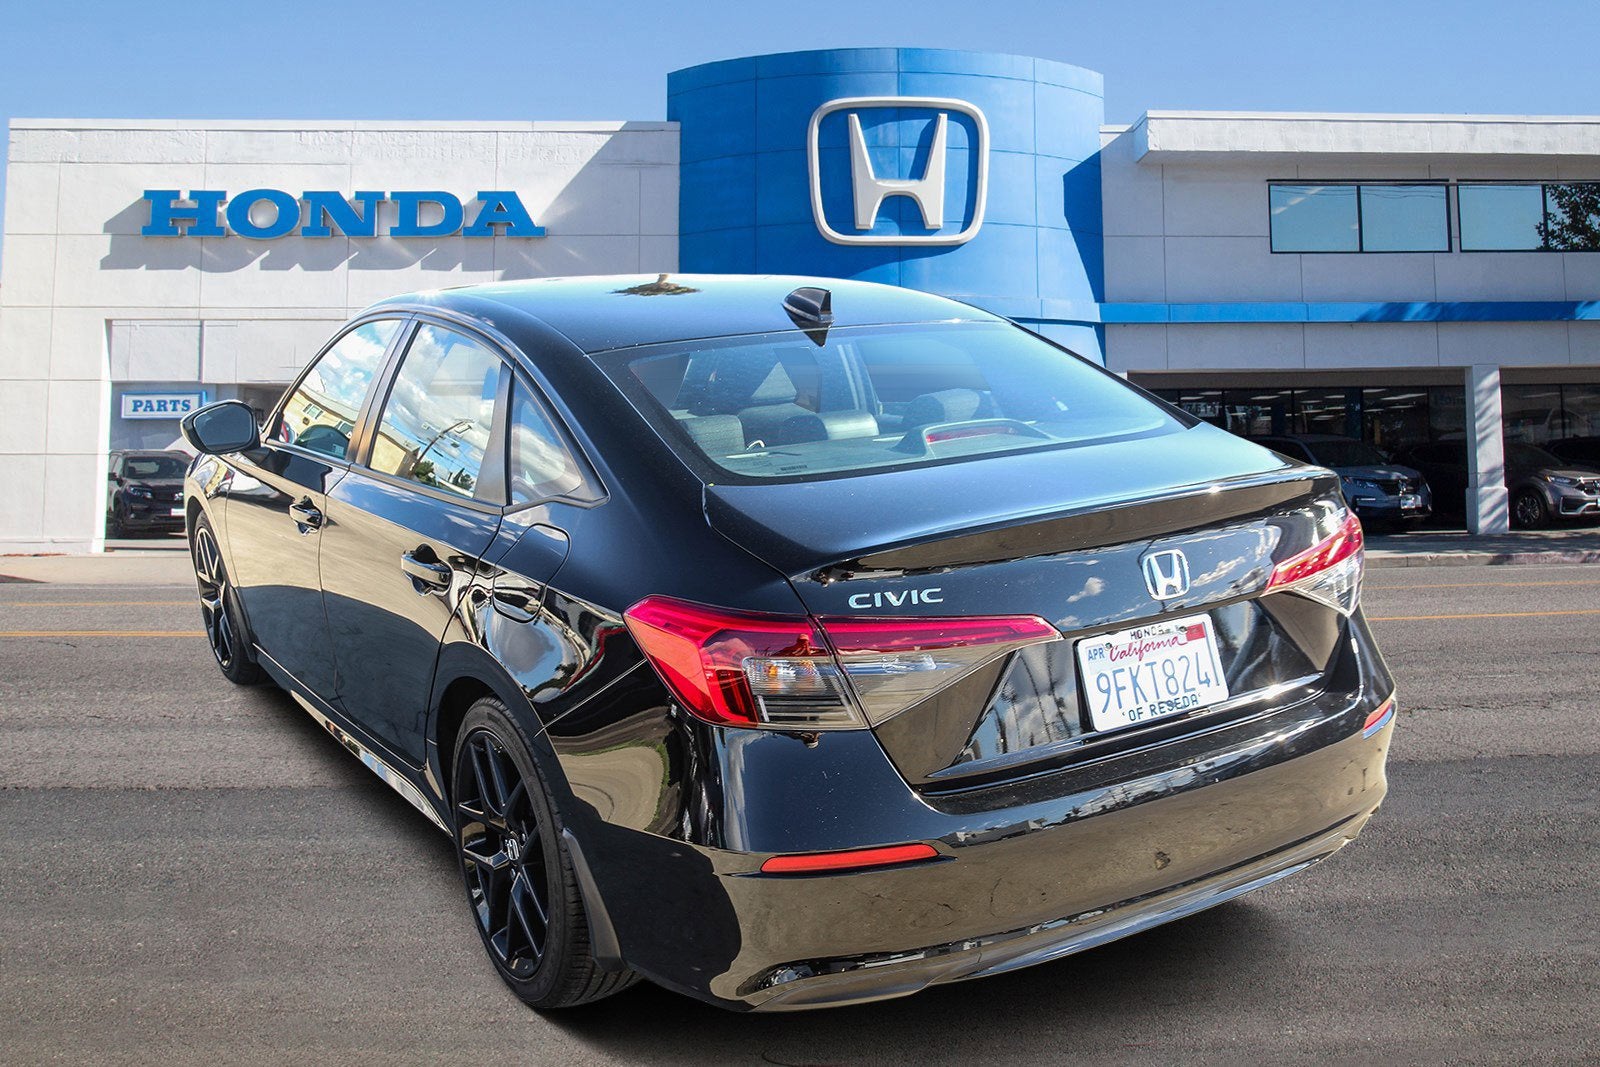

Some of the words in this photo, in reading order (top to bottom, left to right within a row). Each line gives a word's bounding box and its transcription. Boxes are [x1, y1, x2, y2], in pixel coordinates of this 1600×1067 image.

[141, 188, 548, 239] HONDA
[132, 399, 191, 412] PARTS
[848, 588, 944, 609] CIVIC
[1088, 647, 1105, 661] APR
[1110, 633, 1188, 662] California
[1096, 652, 1211, 713] 9FKT824
[1128, 707, 1143, 721] OF
[1149, 694, 1199, 716] RESEDA
